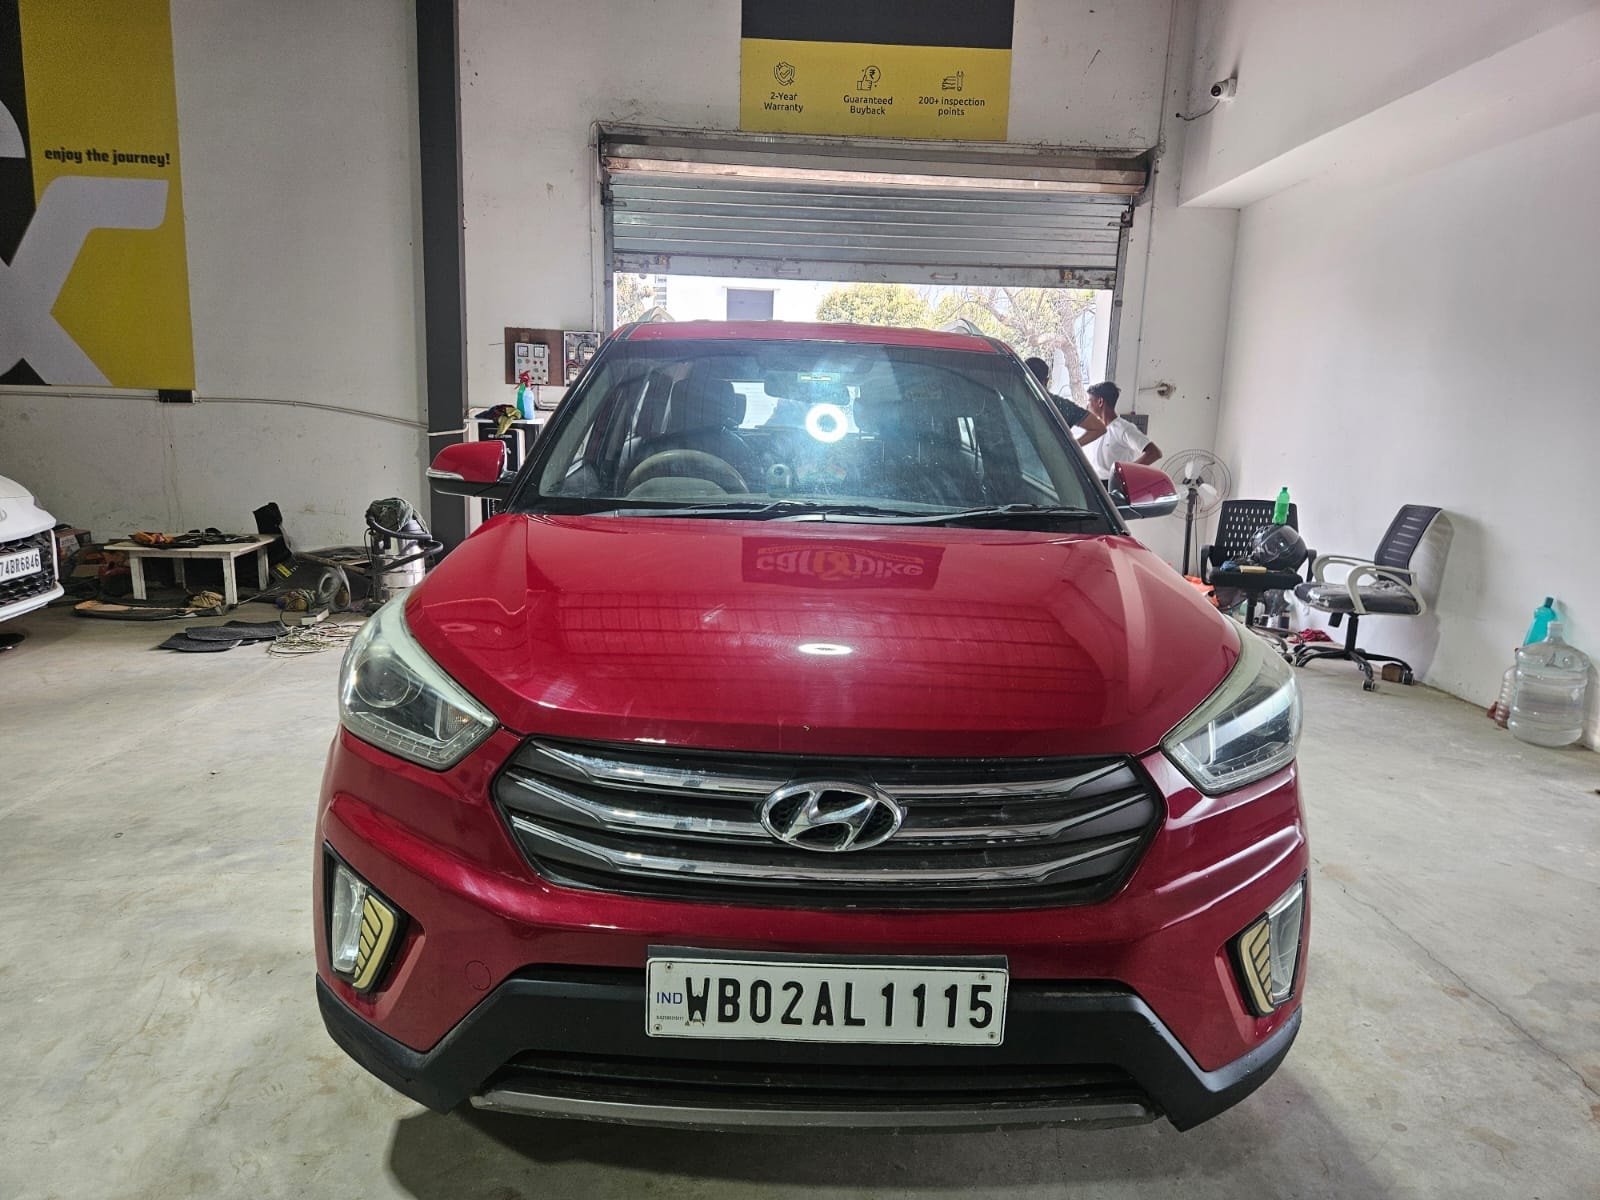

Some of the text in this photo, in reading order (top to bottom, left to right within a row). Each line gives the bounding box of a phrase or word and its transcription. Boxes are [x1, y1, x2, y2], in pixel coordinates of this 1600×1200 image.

[770, 92, 797, 101] 2-Year
[843, 95, 893, 105] Guaranteed
[918, 96, 985, 108] 200+ inspection
[764, 102, 804, 113] Warranty
[850, 105, 886, 116] Buyback
[938, 107, 965, 117] points
[45, 147, 170, 168] enjoy the journey!
[656, 992, 683, 1005] IND
[685, 976, 993, 1029] WB02AL1115
